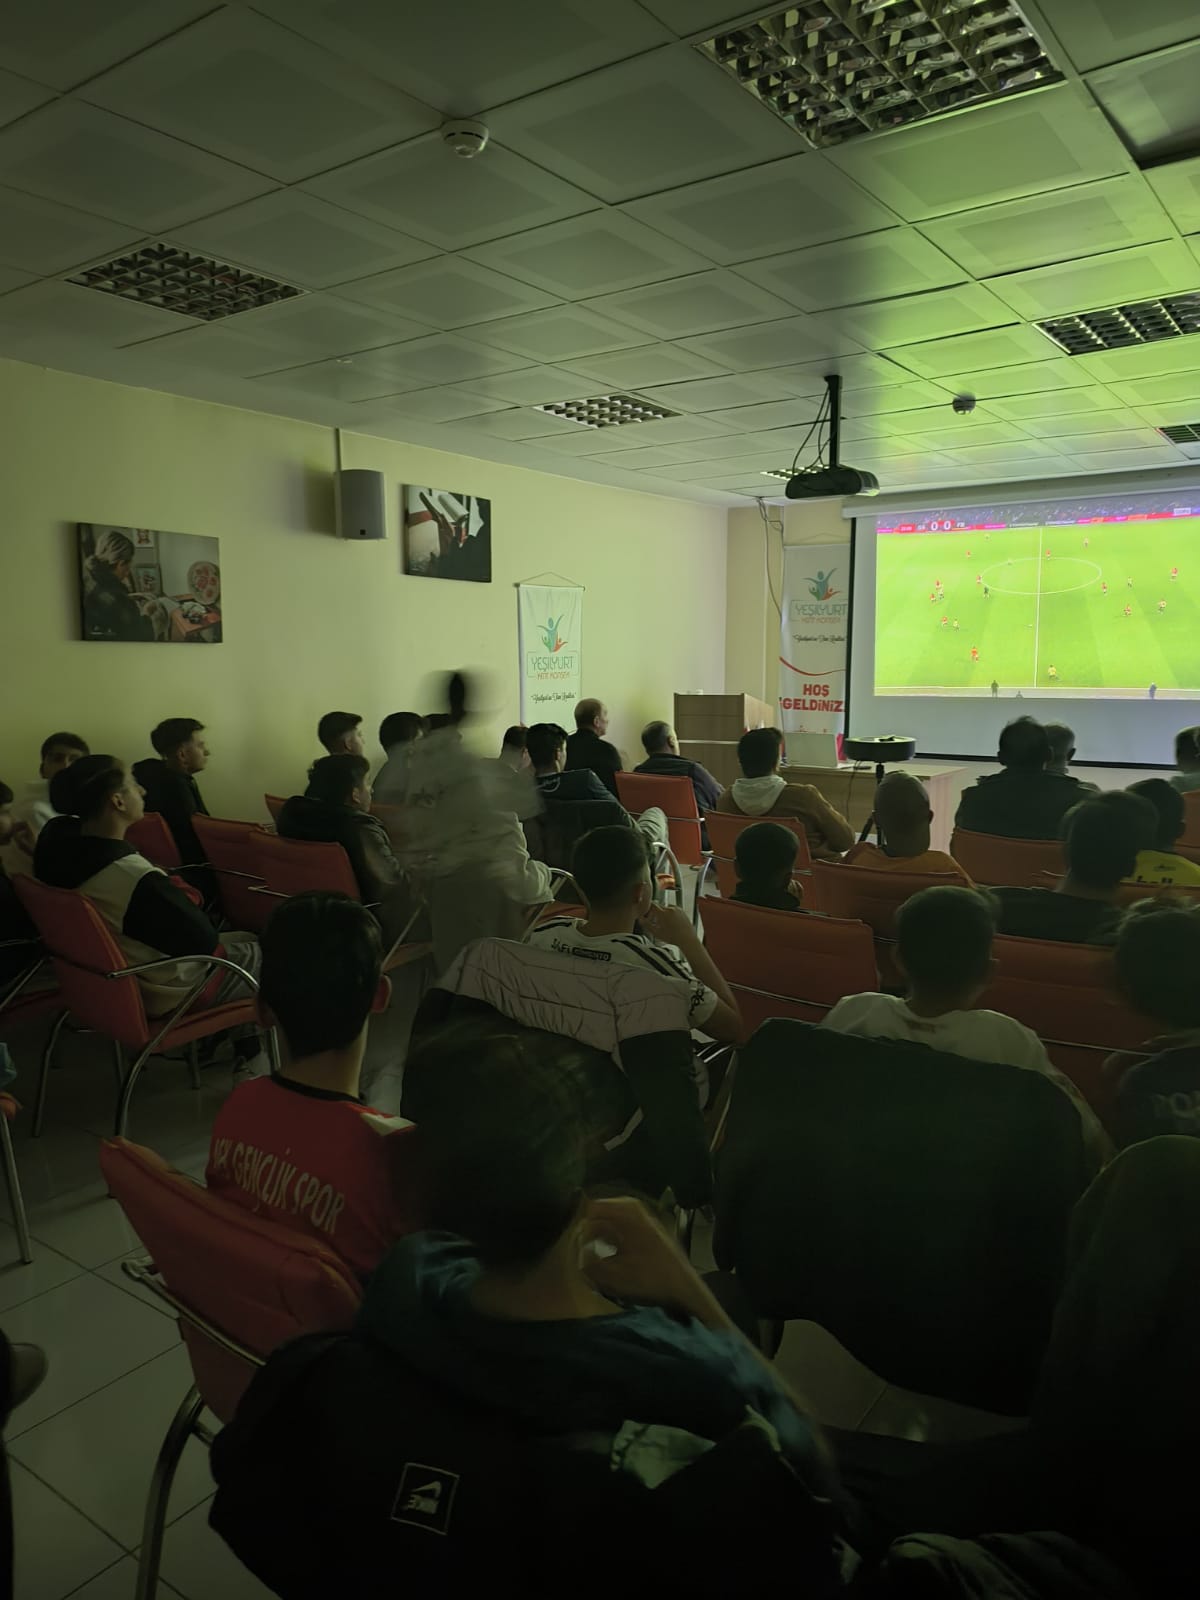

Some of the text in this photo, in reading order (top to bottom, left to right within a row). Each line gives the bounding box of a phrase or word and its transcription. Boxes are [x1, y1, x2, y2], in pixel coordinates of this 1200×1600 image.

[930, 521, 938, 531] 0
[943, 520, 951, 530] 0
[803, 684, 830, 697] HOŞ
[291, 1171, 345, 1235] SPOR
